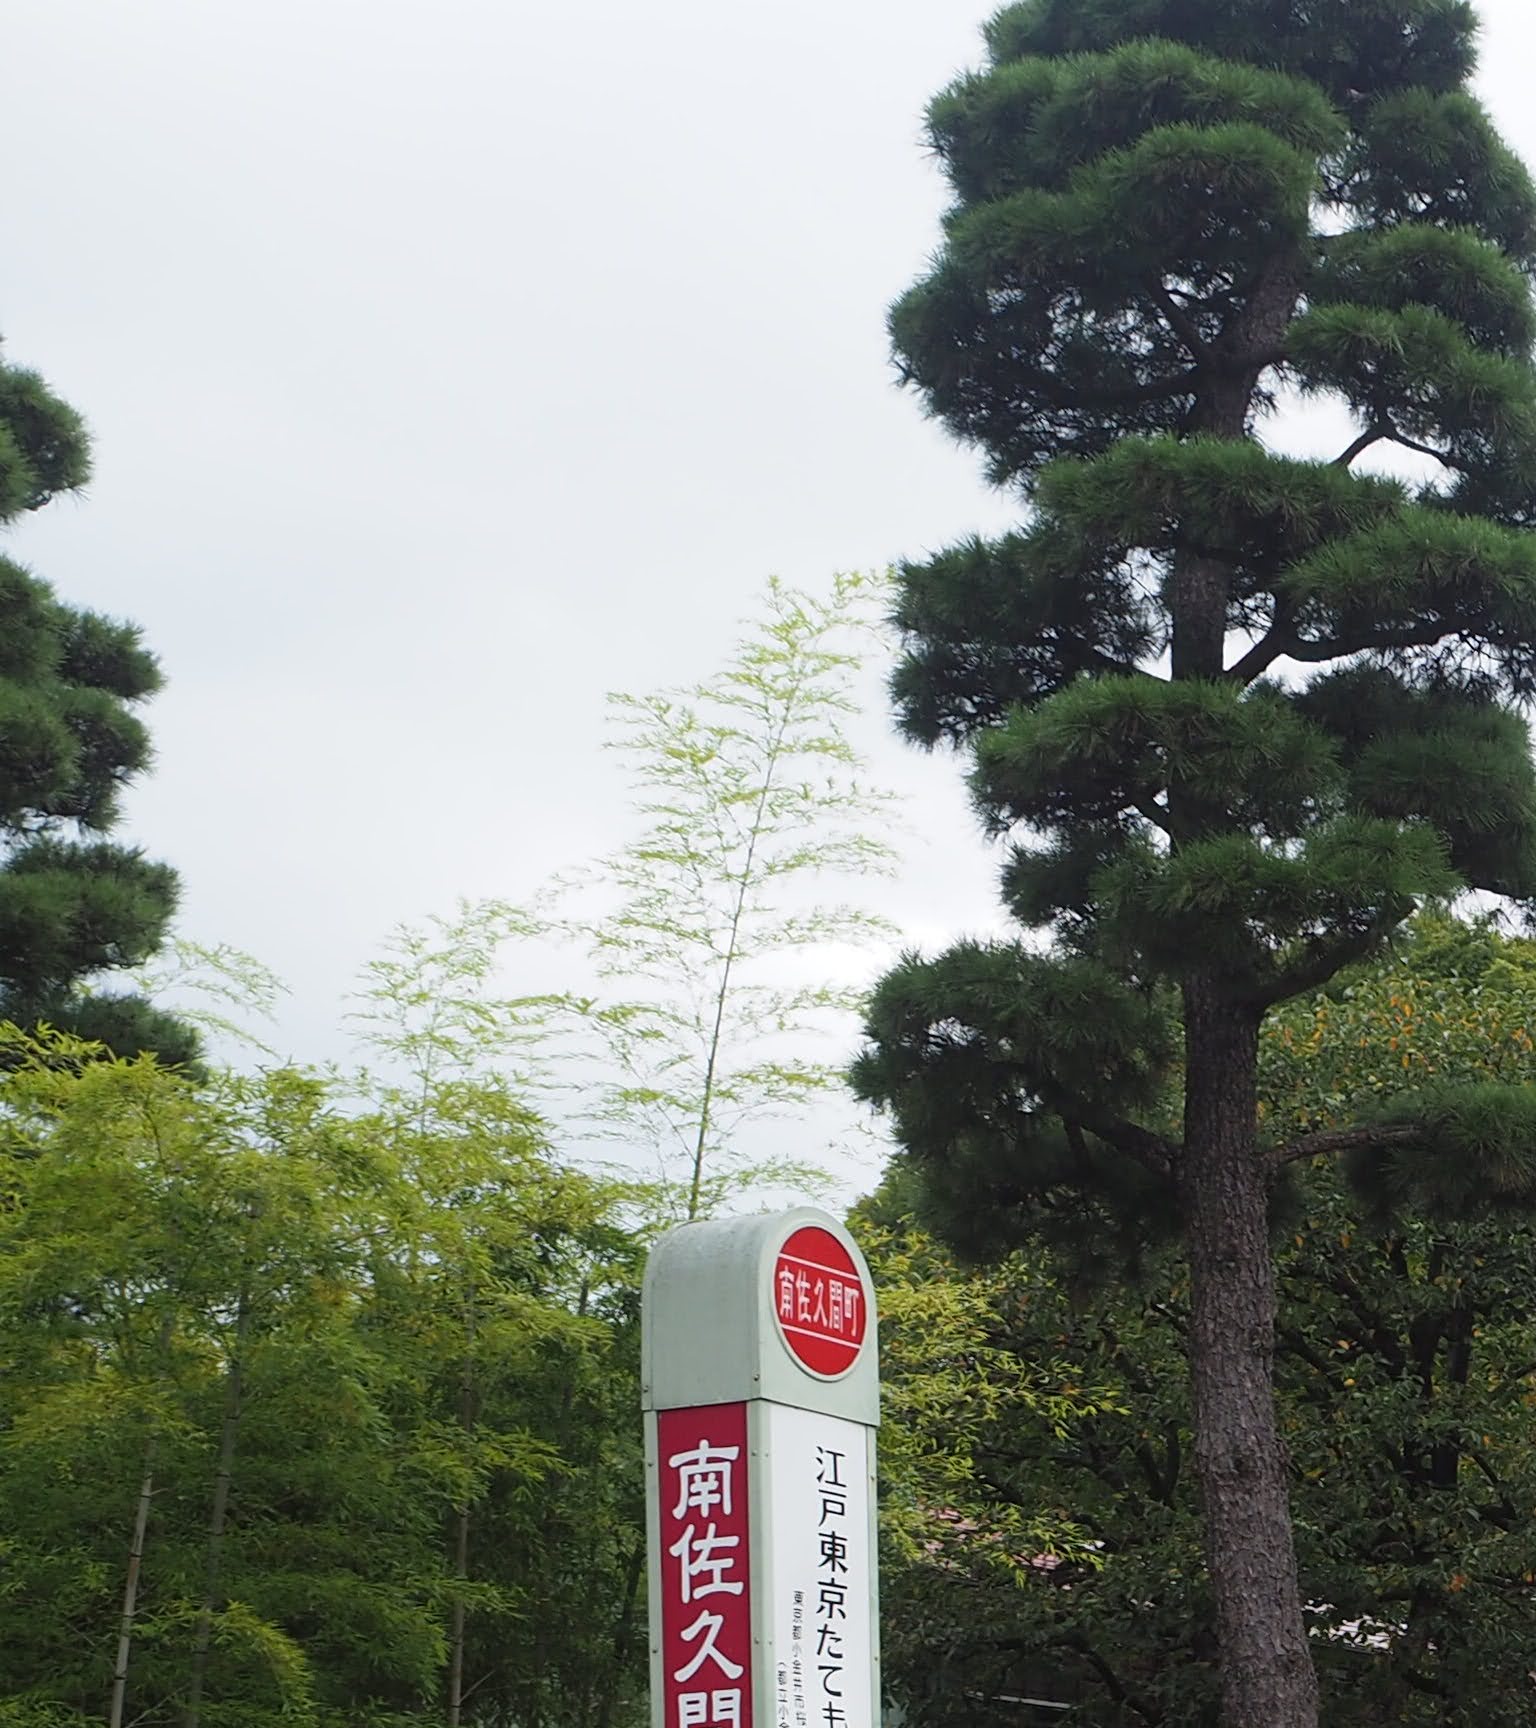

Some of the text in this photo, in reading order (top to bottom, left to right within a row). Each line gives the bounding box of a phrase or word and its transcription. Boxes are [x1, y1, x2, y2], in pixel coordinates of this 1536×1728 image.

[778, 1265, 859, 1337] 南佐久間町
